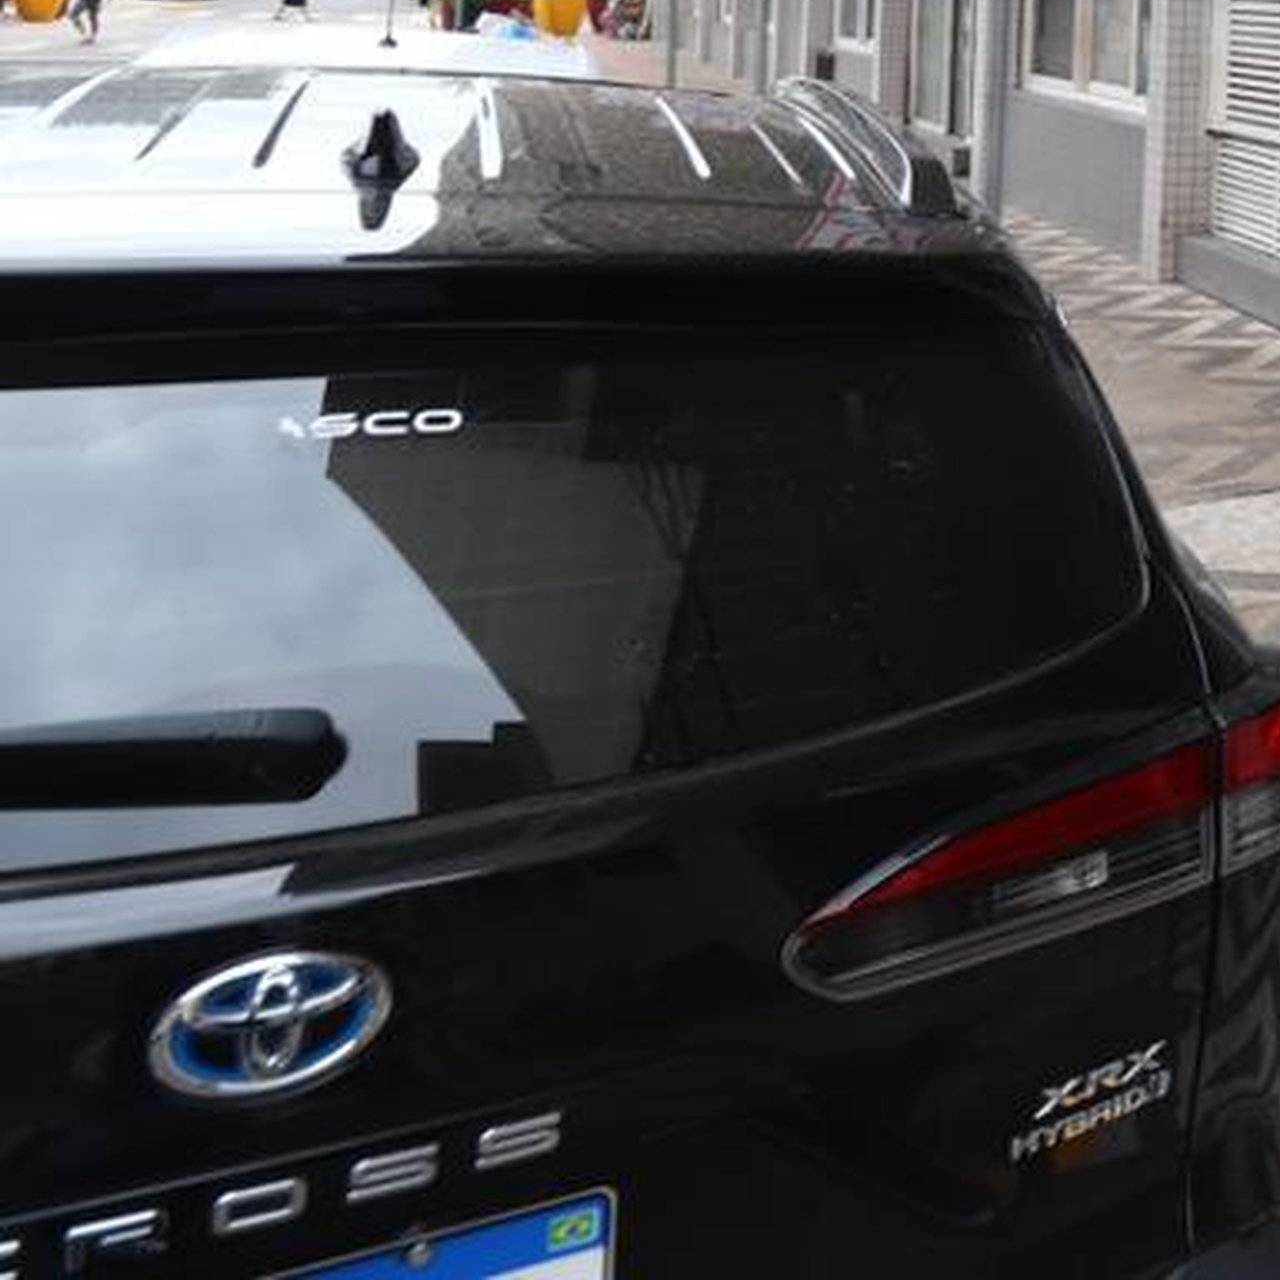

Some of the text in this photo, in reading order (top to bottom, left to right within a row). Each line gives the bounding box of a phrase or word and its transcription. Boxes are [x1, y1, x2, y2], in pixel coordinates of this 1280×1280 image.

[1033, 1038, 1168, 1120] XRX
[1010, 1086, 1149, 1161] HYBRID
[0, 1109, 563, 1280] ROSS
